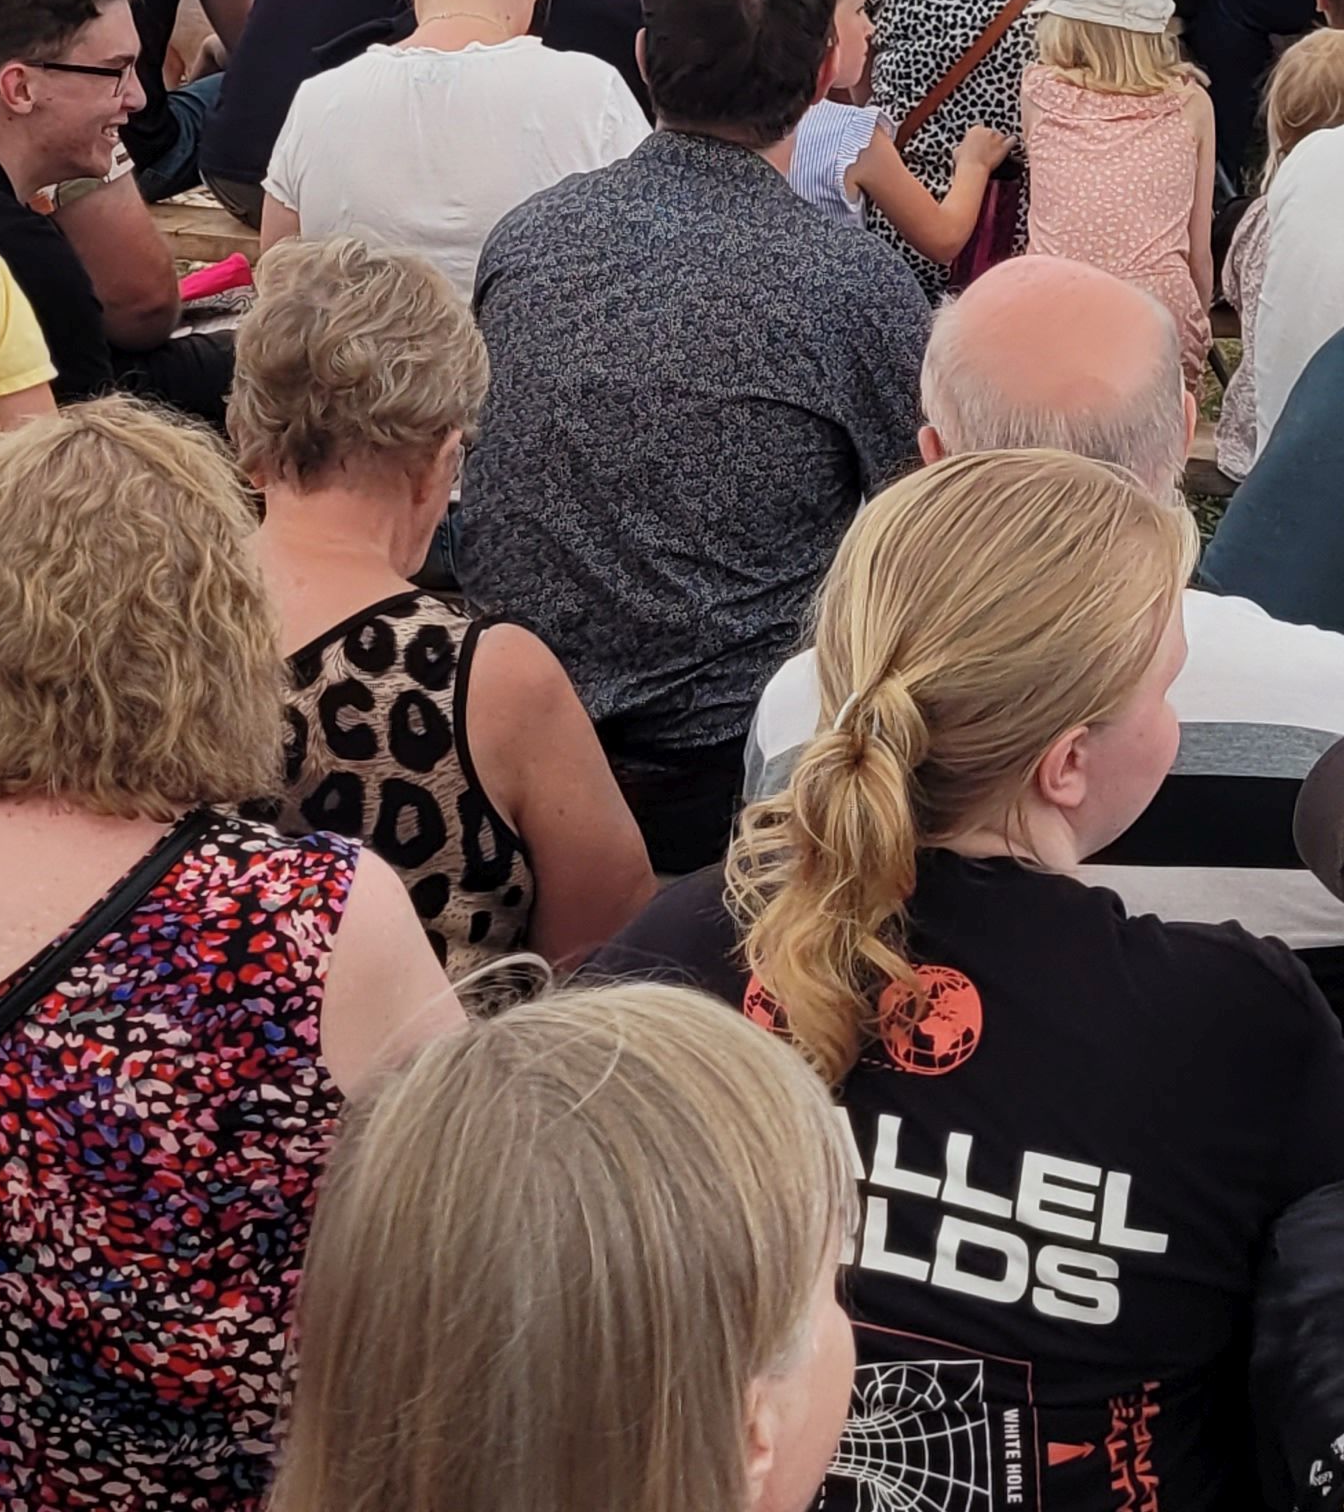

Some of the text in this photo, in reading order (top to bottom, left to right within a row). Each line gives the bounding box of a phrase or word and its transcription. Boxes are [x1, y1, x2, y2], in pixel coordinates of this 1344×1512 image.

[834, 1106, 1169, 1254] LLEL
[836, 1195, 1121, 1325] LDS
[1003, 1407, 1023, 1504] WHITE HOLE
